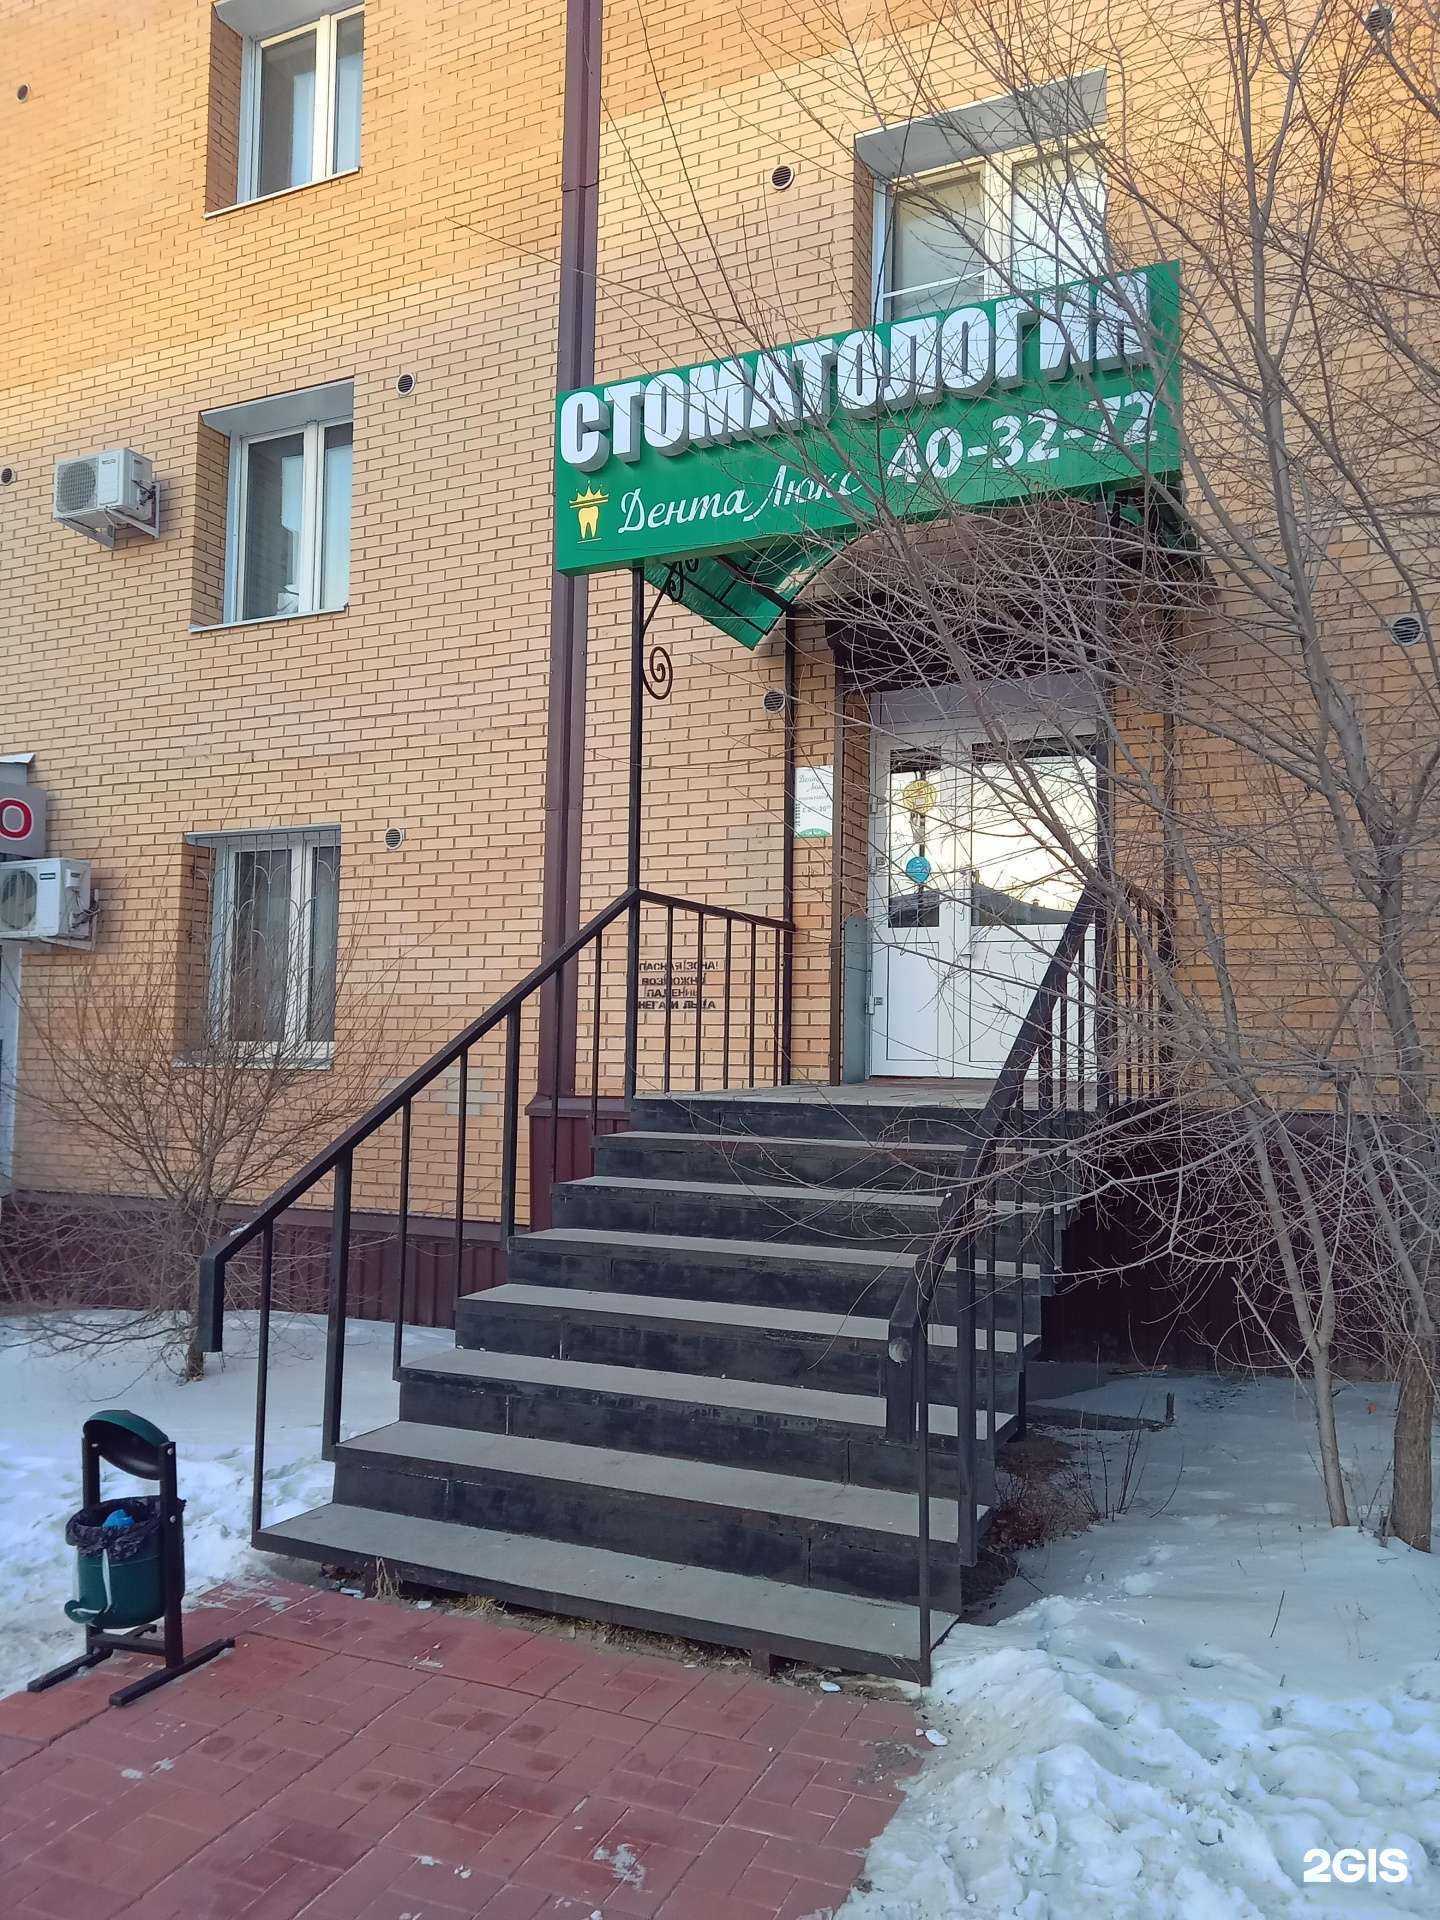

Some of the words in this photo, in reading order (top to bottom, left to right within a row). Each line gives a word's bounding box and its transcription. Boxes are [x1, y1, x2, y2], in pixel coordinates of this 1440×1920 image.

[560, 272, 1149, 465] СТОМАТОЛОГИЯ
[886, 390, 1159, 483] 40-32-72
[617, 487, 753, 534] Дента
[743, 464, 863, 522] Люкс
[638, 961, 683, 971] ПАСНАЯ
[638, 1000, 666, 1010] НЕГА
